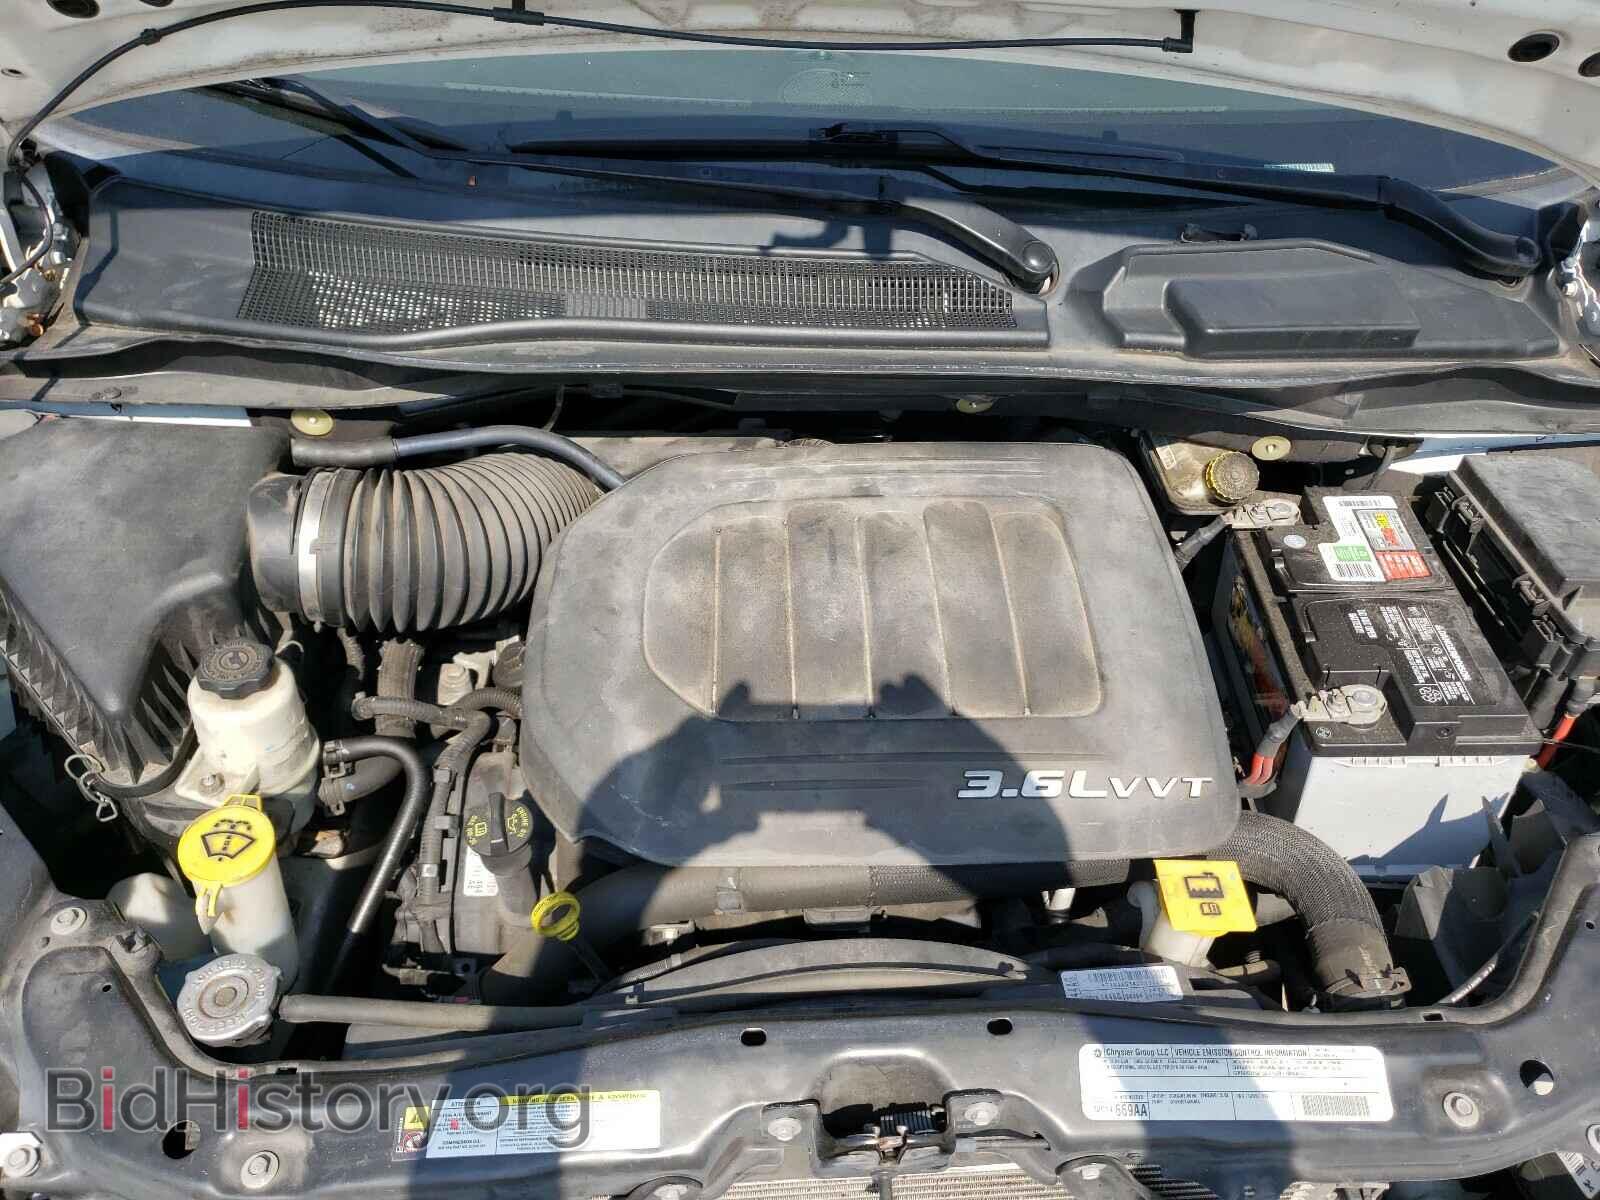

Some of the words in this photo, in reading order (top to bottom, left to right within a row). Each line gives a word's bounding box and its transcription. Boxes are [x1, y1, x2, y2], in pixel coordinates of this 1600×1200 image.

[1105, 1047, 1133, 1058] Chrysler
[1134, 1048, 1155, 1058] Group
[1156, 1047, 1170, 1057] LLC
[1174, 1048, 1201, 1057] VEHICLE
[1202, 1047, 1233, 1057] EMISSION
[1234, 1048, 1263, 1057] CONTROL
[1264, 1048, 1307, 1057] INFORMATION
